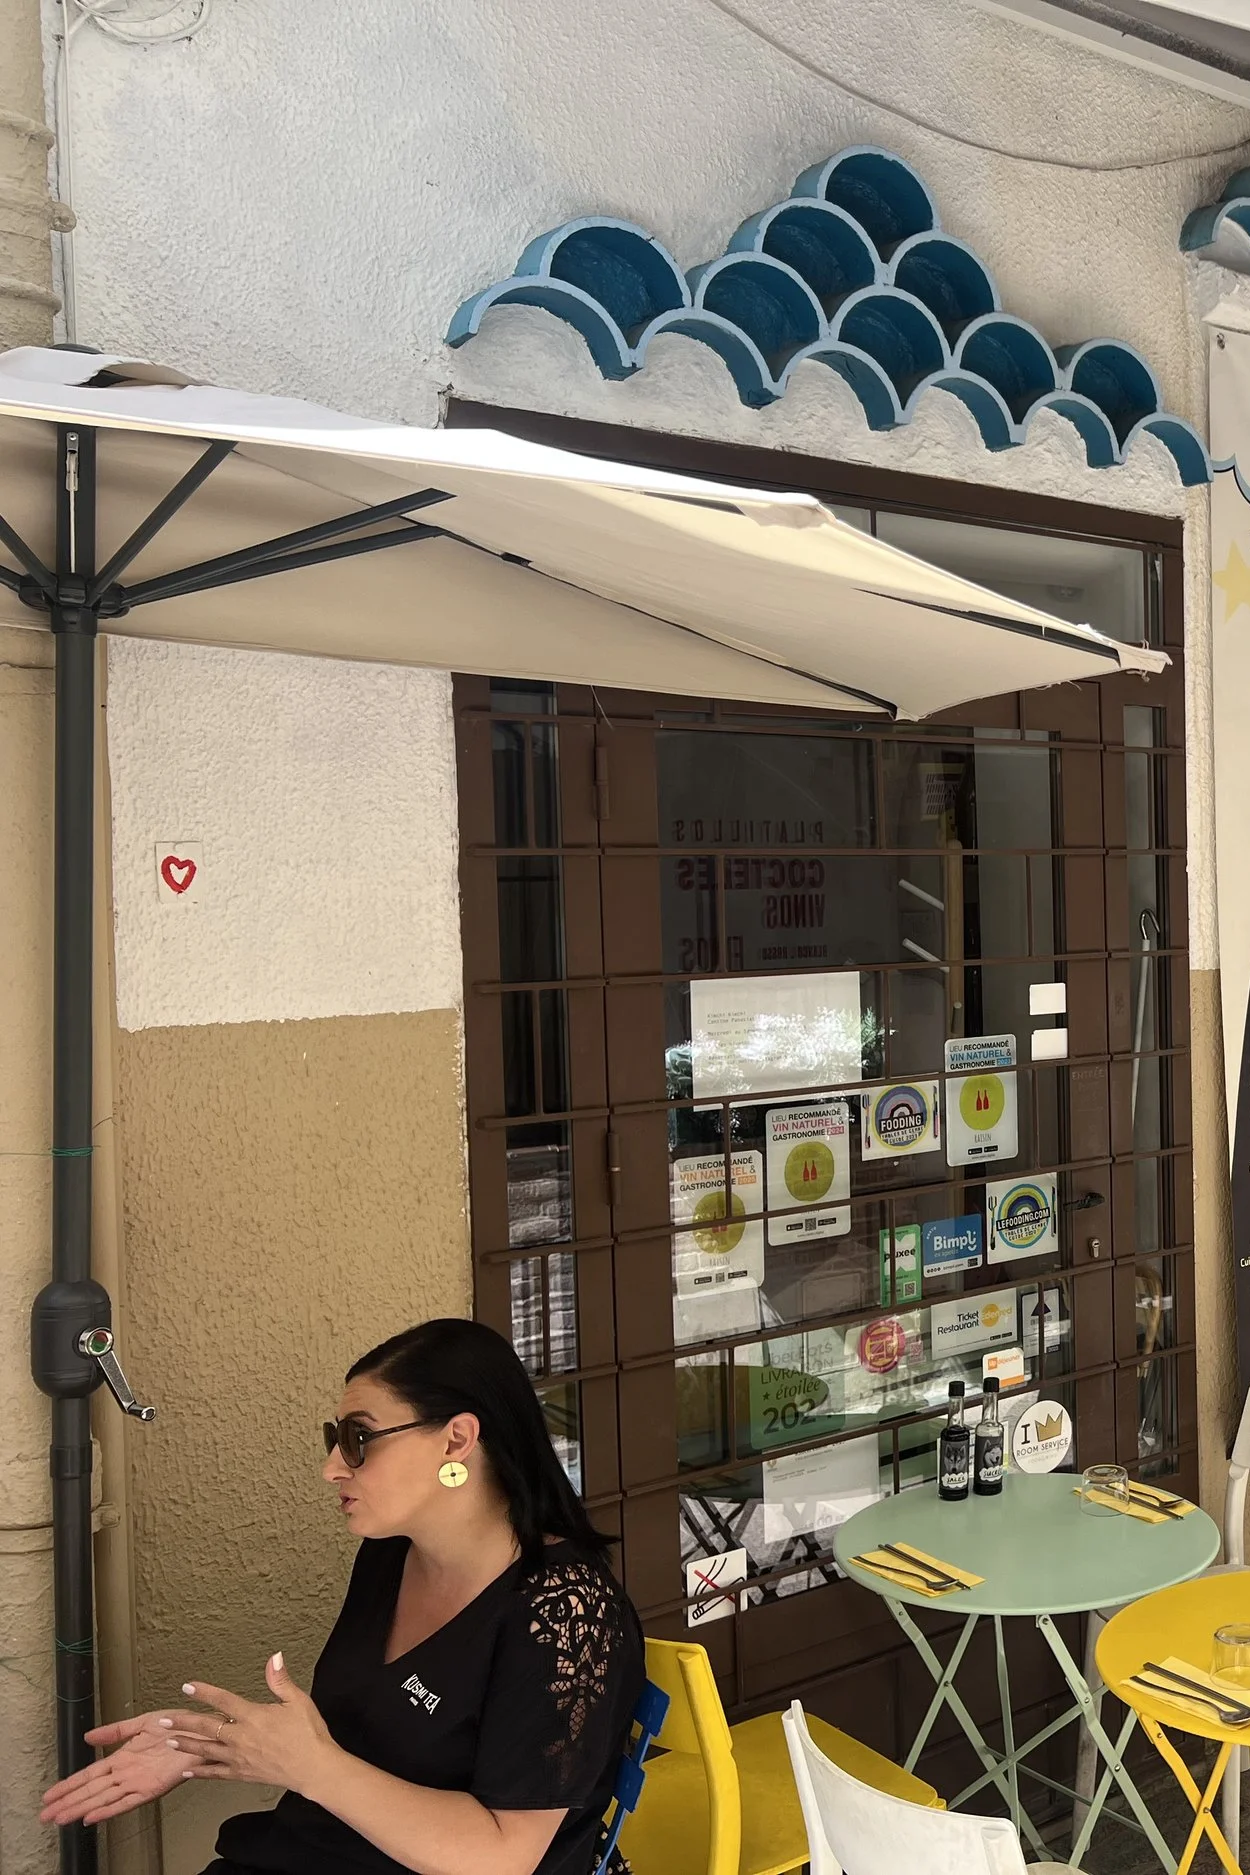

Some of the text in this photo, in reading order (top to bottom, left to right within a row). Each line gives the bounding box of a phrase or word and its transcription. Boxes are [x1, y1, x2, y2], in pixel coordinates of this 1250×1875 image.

[963, 1040, 1009, 1051] RECOMMANDÉ
[950, 1048, 1011, 1062] VIN NATUREL &
[950, 1060, 996, 1071] GASTRONOMIE
[788, 1107, 841, 1121] RECOMMANDÉ
[881, 1114, 922, 1131] FOODING
[772, 1116, 844, 1132] VIN NATUREL &
[772, 1129, 826, 1141] GASTRONOMIE
[679, 1155, 753, 1172] LIEU RECOMANDÉ
[680, 1172, 697, 1182] VIN
[749, 1164, 755, 1174] &
[997, 1208, 1049, 1230] LEFOODING.COM
[957, 1310, 979, 1322] Ticket
[937, 1319, 979, 1336] Restaurant
[775, 1377, 821, 1400] étoilée
[1021, 1423, 1031, 1445] I
[1016, 1437, 1069, 1457] ROOM SERVICE
[401, 1673, 442, 1715] KUSMI TEA
